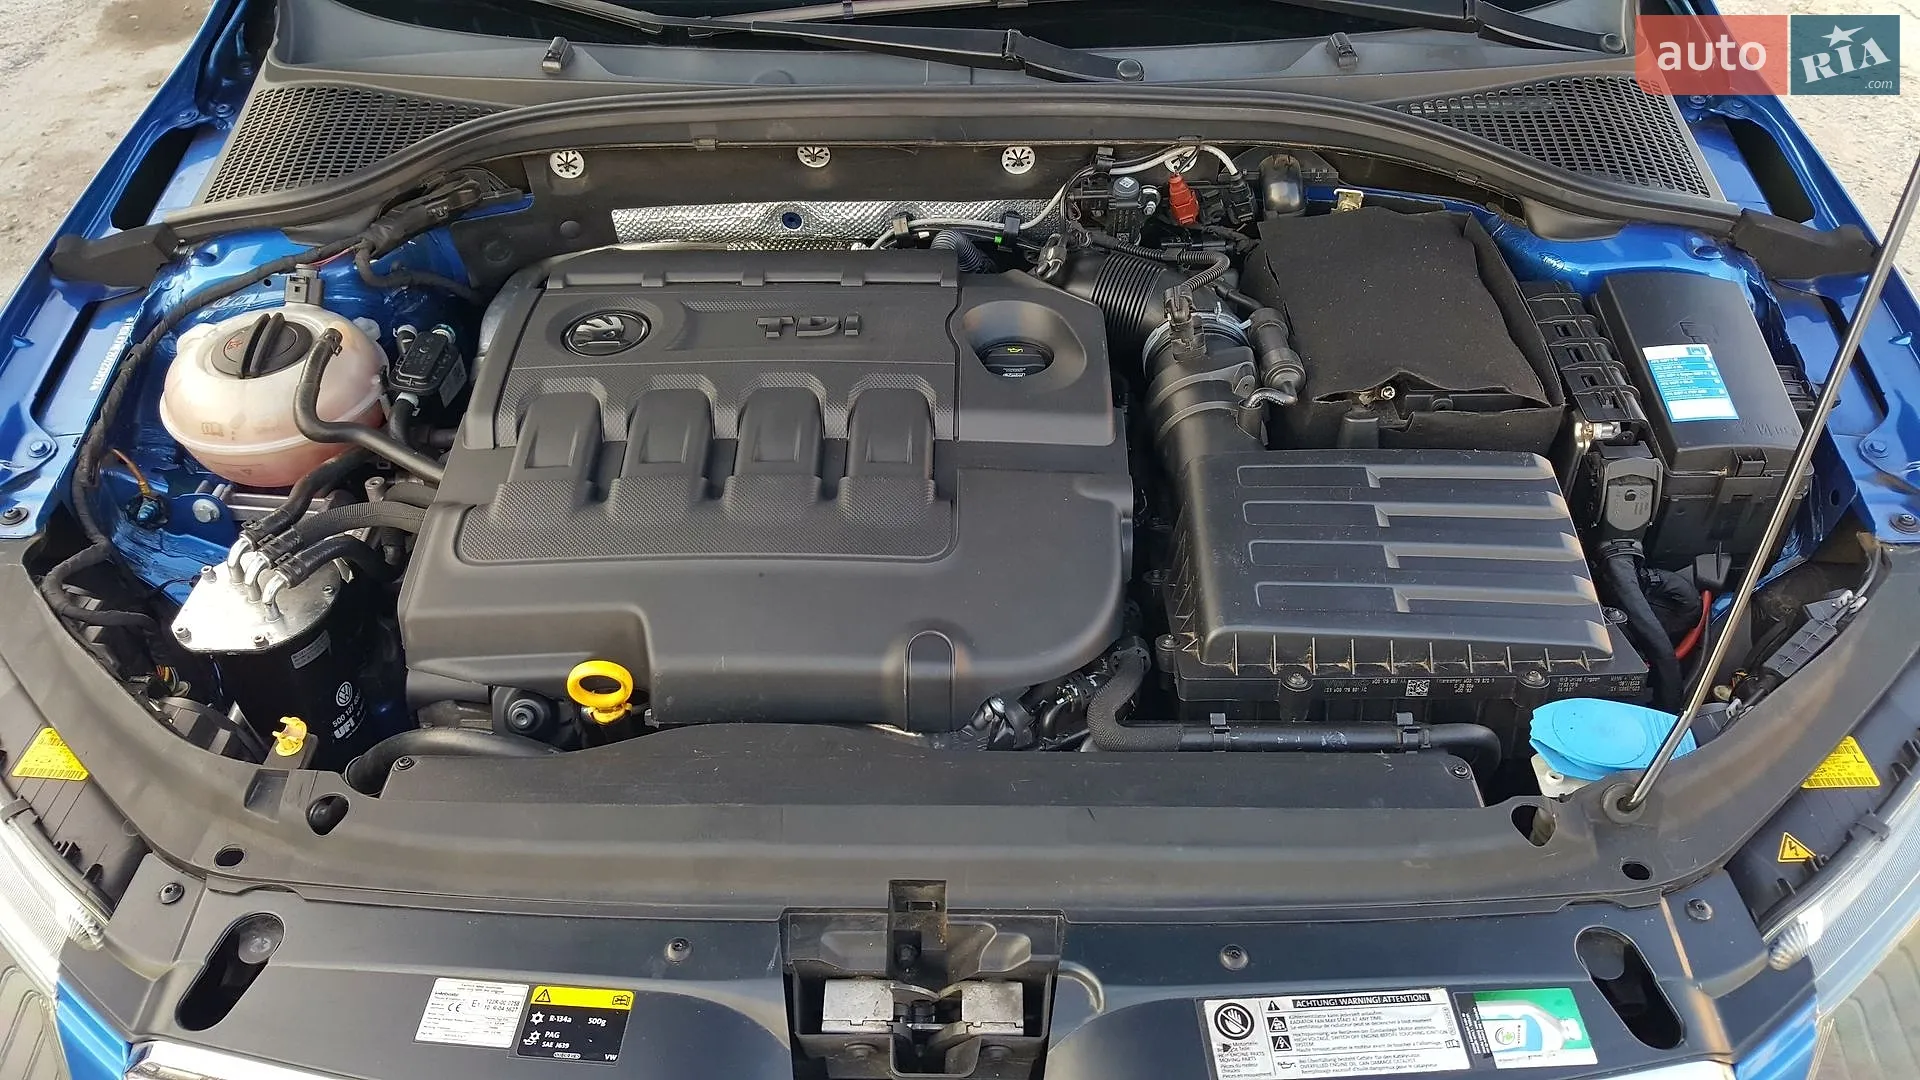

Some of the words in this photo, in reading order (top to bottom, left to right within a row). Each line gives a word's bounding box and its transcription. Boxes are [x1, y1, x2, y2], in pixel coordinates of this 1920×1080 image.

[756, 316, 861, 338] TDI
[333, 717, 355, 739] UFI
[1296, 999, 1338, 1008] ACHTUNG!
[1340, 996, 1381, 1006] WARNING!
[1382, 994, 1428, 1003] ATTENTION!
[549, 1014, 572, 1023] R-134a
[587, 1017, 607, 1027] 500g
[544, 1030, 560, 1038] PAG
